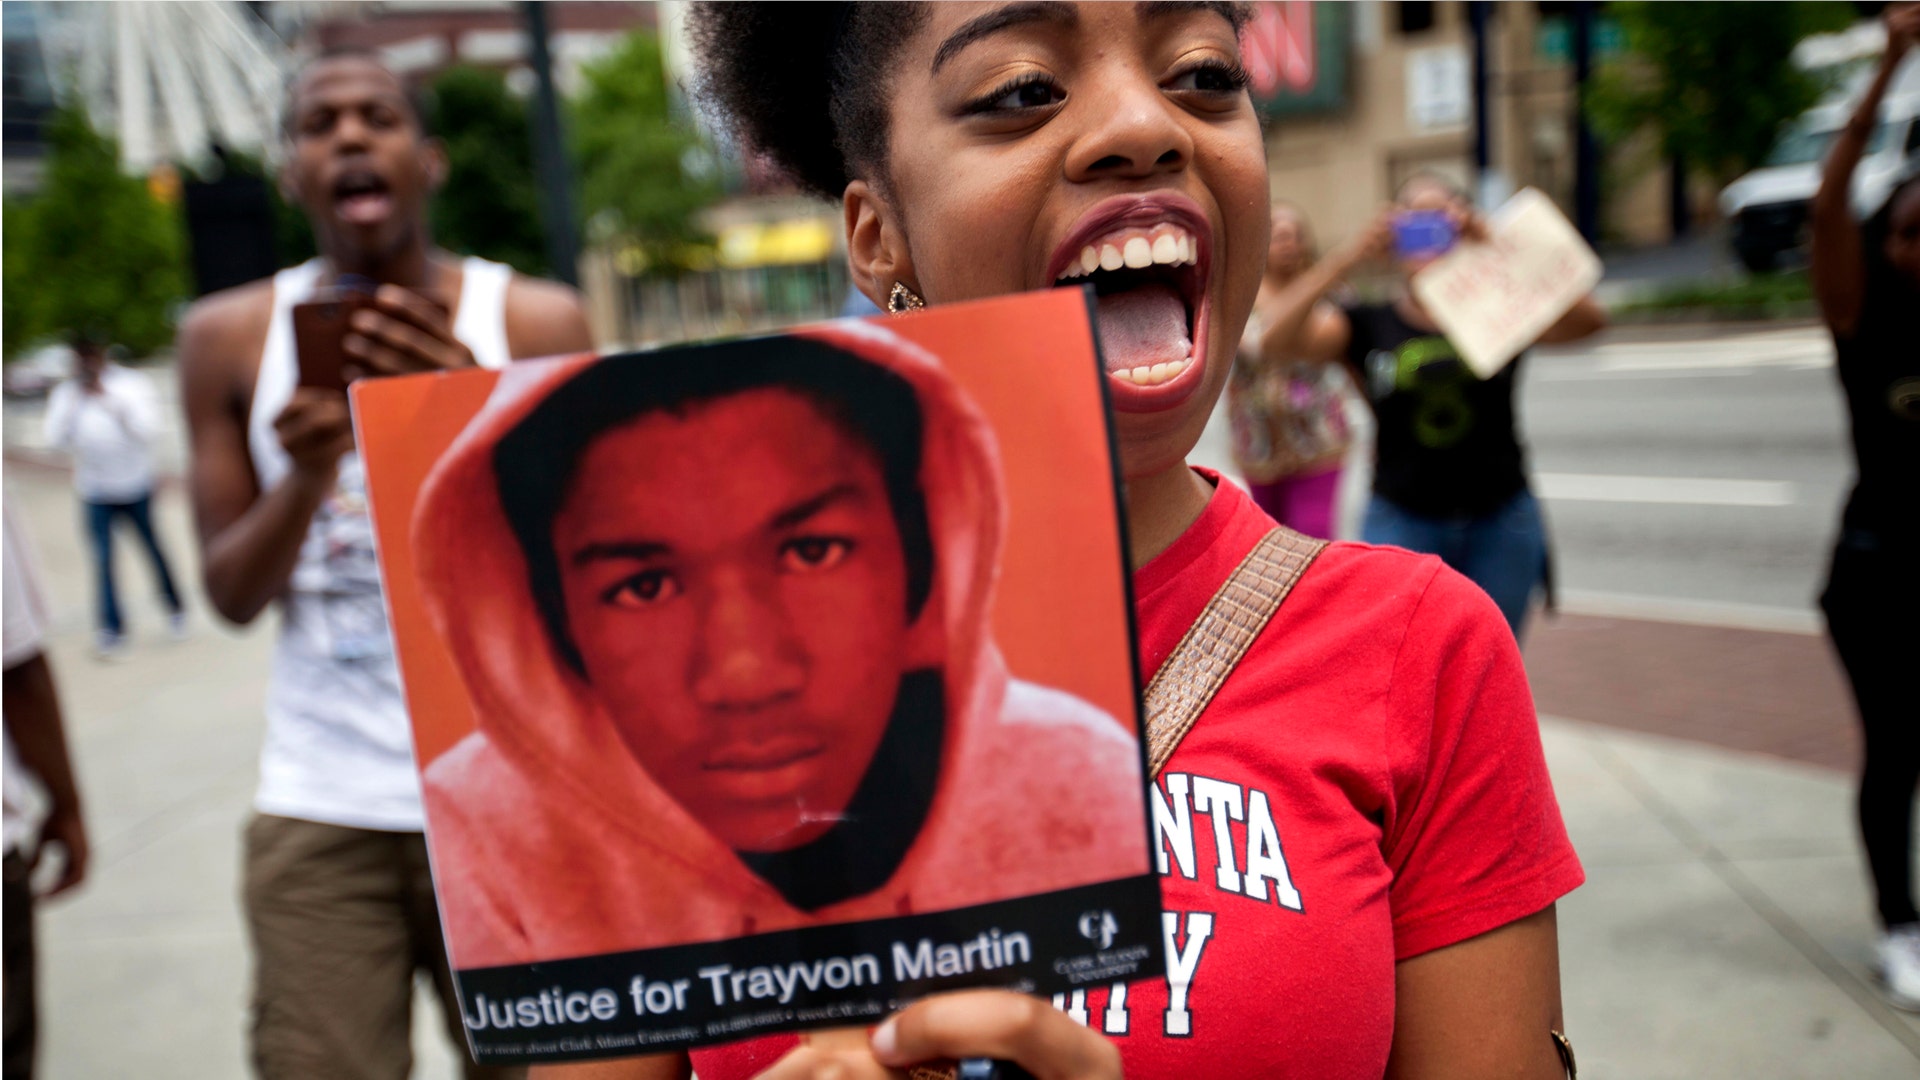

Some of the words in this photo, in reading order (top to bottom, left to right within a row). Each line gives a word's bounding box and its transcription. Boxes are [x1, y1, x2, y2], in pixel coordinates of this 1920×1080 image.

[465, 985, 618, 1030] Justice
[629, 975, 691, 1016] for
[699, 953, 880, 1006] Trayvon
[891, 927, 1031, 982] Martin
